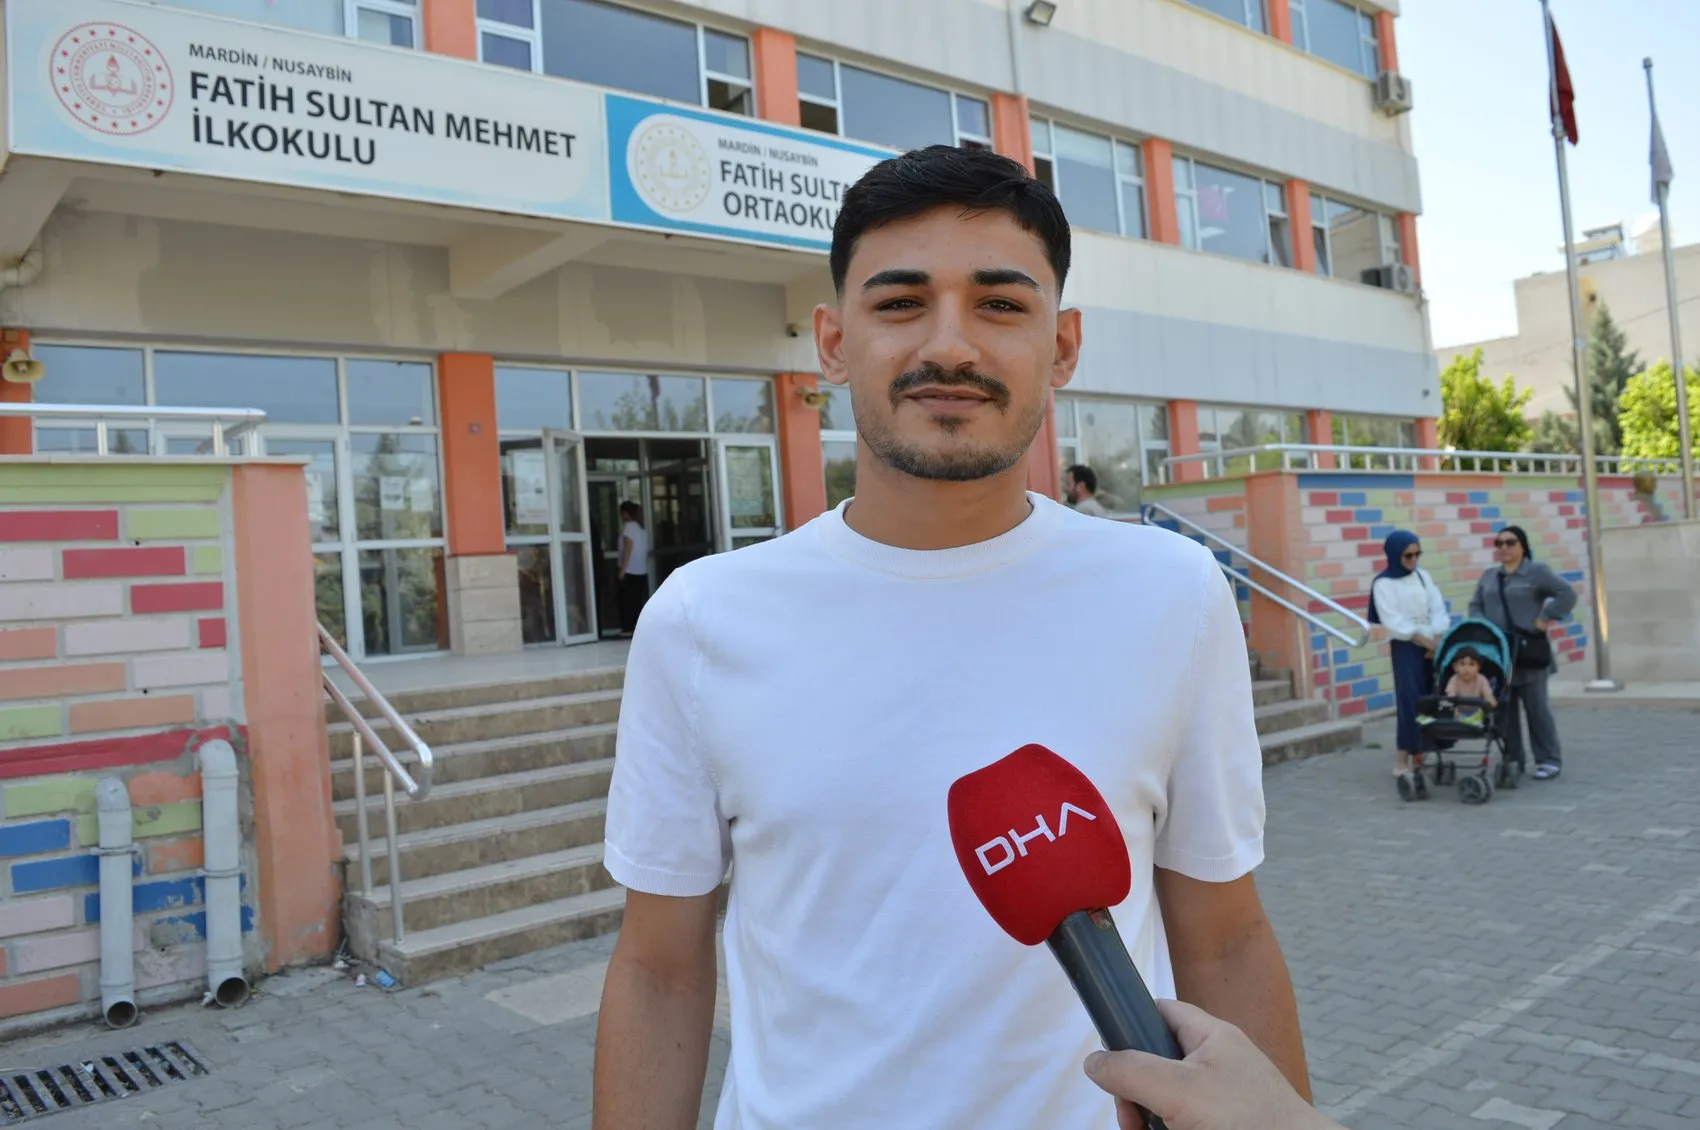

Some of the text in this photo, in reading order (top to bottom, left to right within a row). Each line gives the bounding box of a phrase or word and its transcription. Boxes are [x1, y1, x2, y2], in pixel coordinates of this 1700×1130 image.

[189, 44, 352, 83] MARDİN / NUSAYBİN
[190, 71, 294, 114] FATİH
[306, 90, 435, 136] SULTAN
[446, 112, 576, 158] MEHMET
[192, 107, 376, 165] İLKOKULU
[721, 160, 783, 192] FATİH
[975, 802, 1096, 875] DHA
